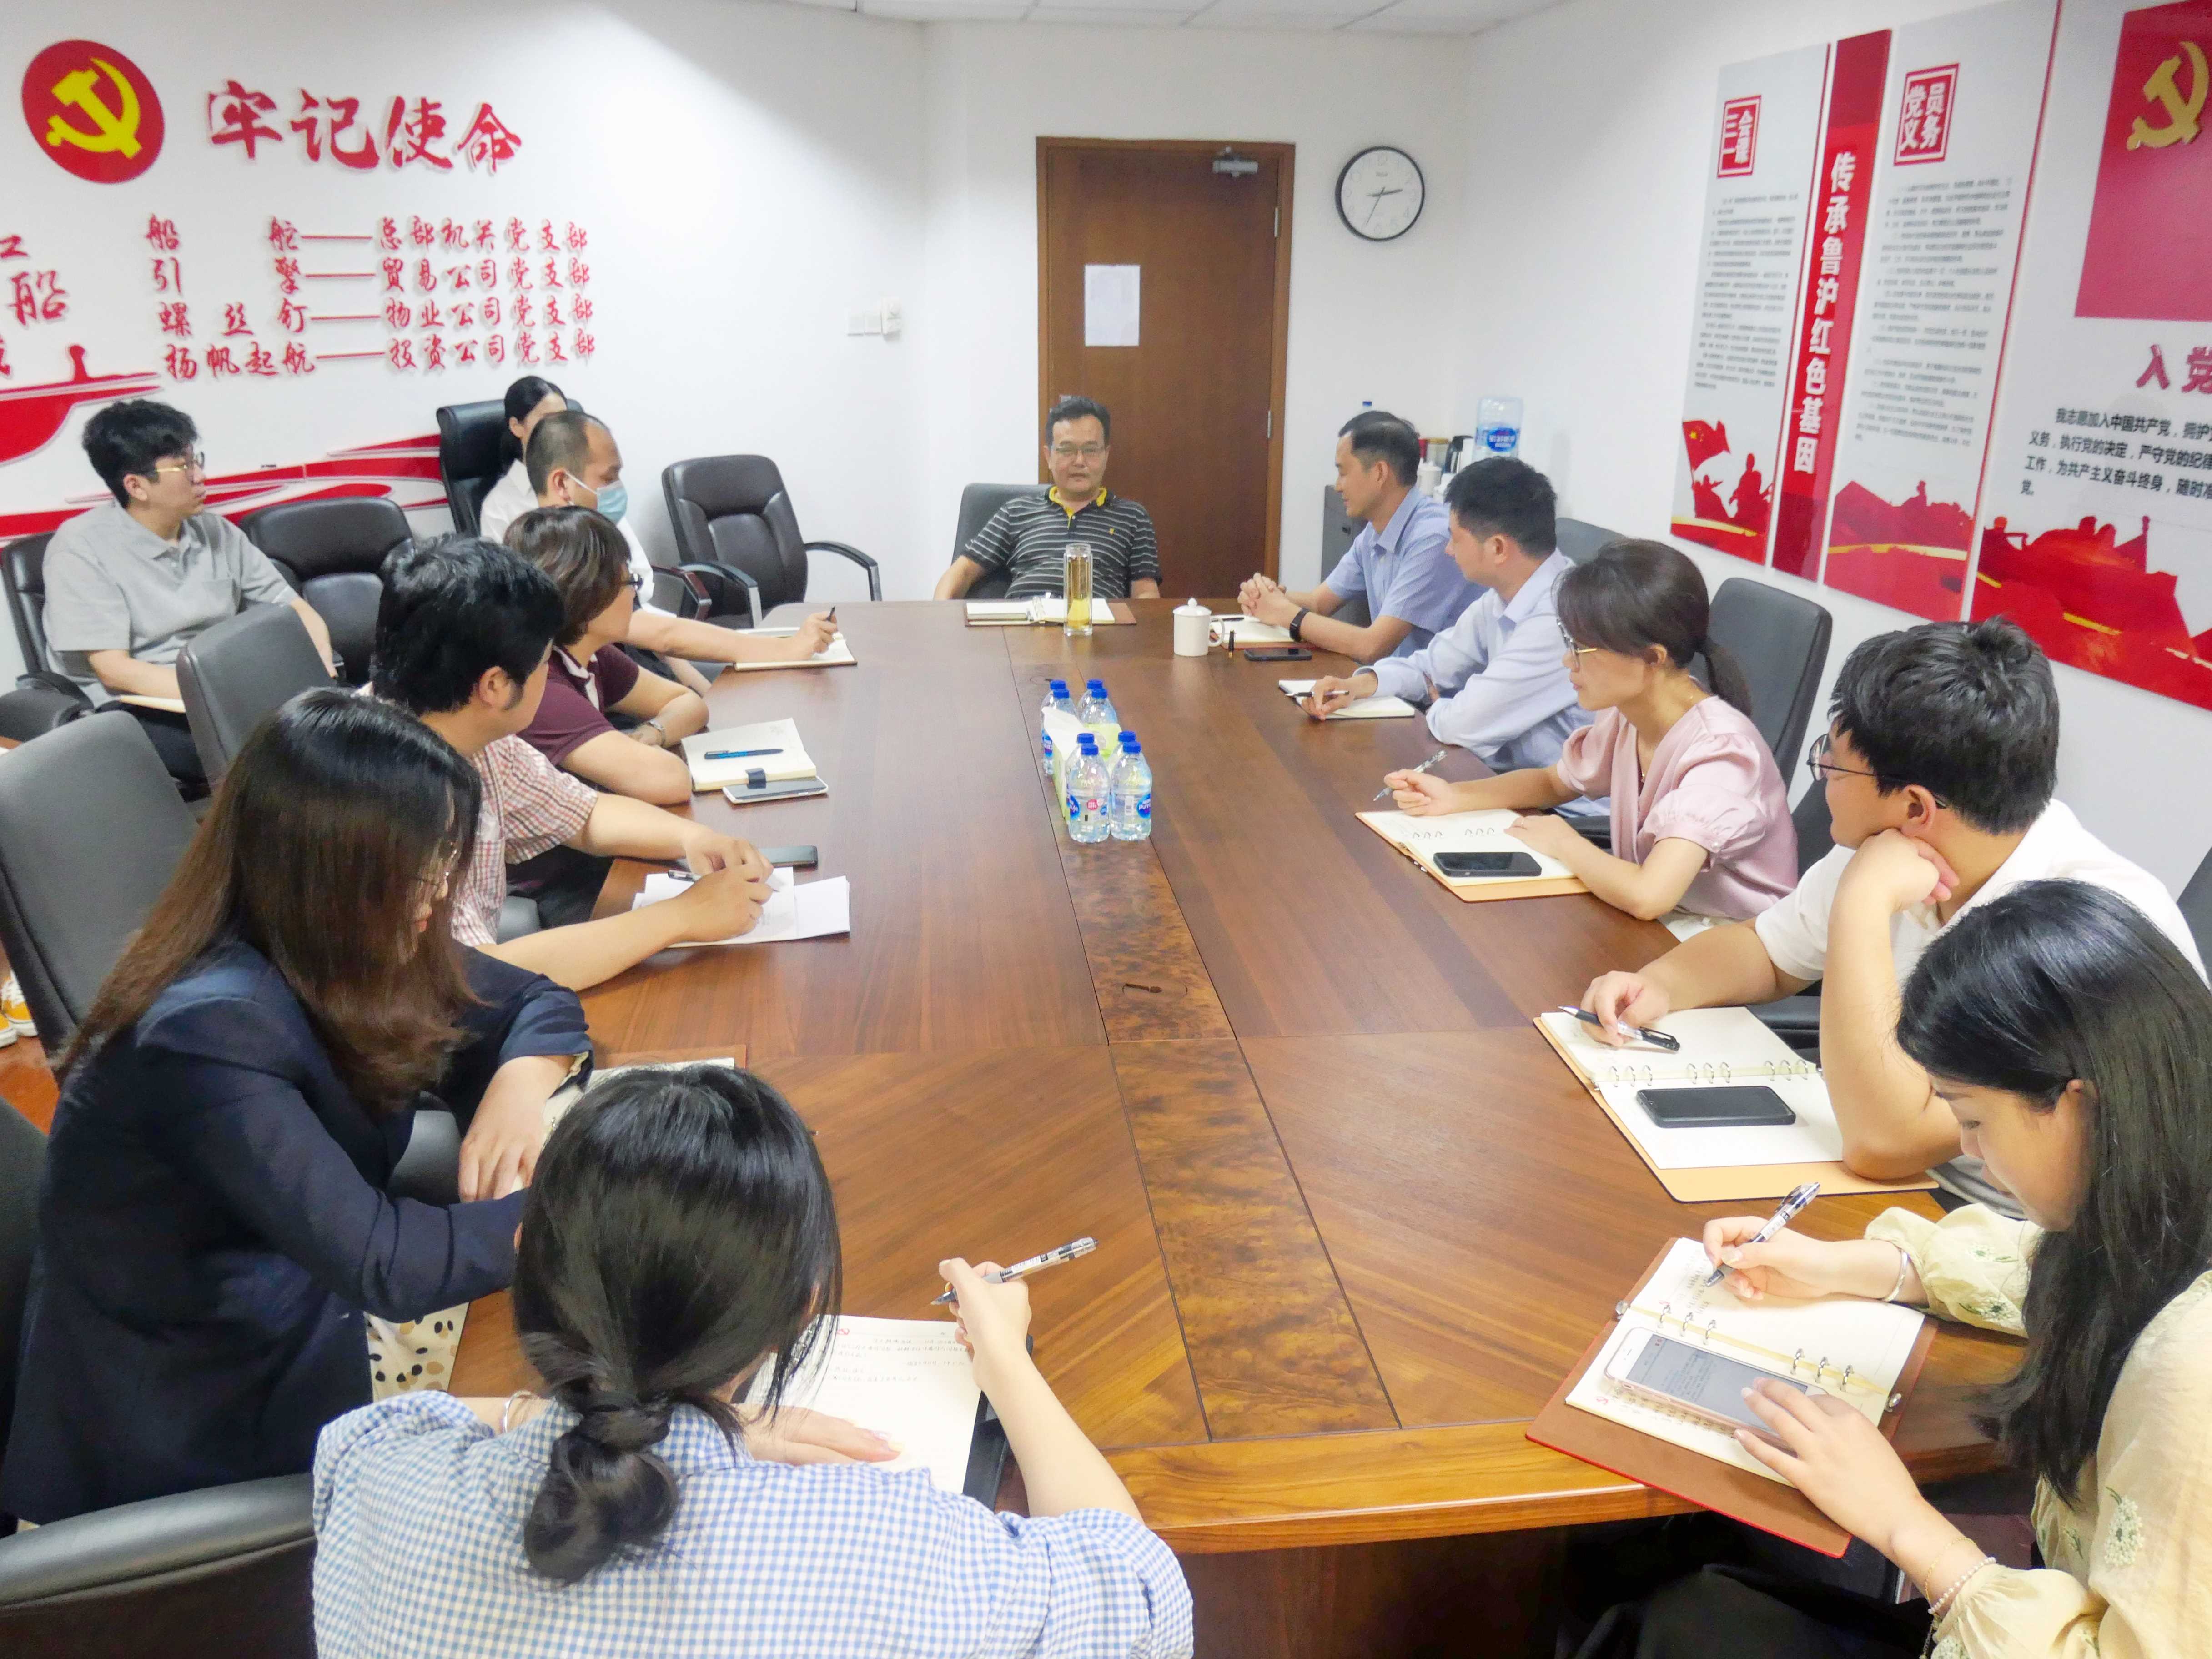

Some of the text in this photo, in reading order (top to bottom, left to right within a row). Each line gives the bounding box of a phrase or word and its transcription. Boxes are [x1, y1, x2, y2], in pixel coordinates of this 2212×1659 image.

[208, 80, 522, 173] 牢记使命
[381, 216, 588, 251] 总部机关党支部
[151, 256, 182, 295] 引
[159, 302, 191, 337] 螺
[386, 294, 593, 328] 物业公司党支部
[1793, 151, 1857, 474] 传承鲁沪红色基因
[165, 329, 595, 379] 扬帆起航 投资公司党支部
